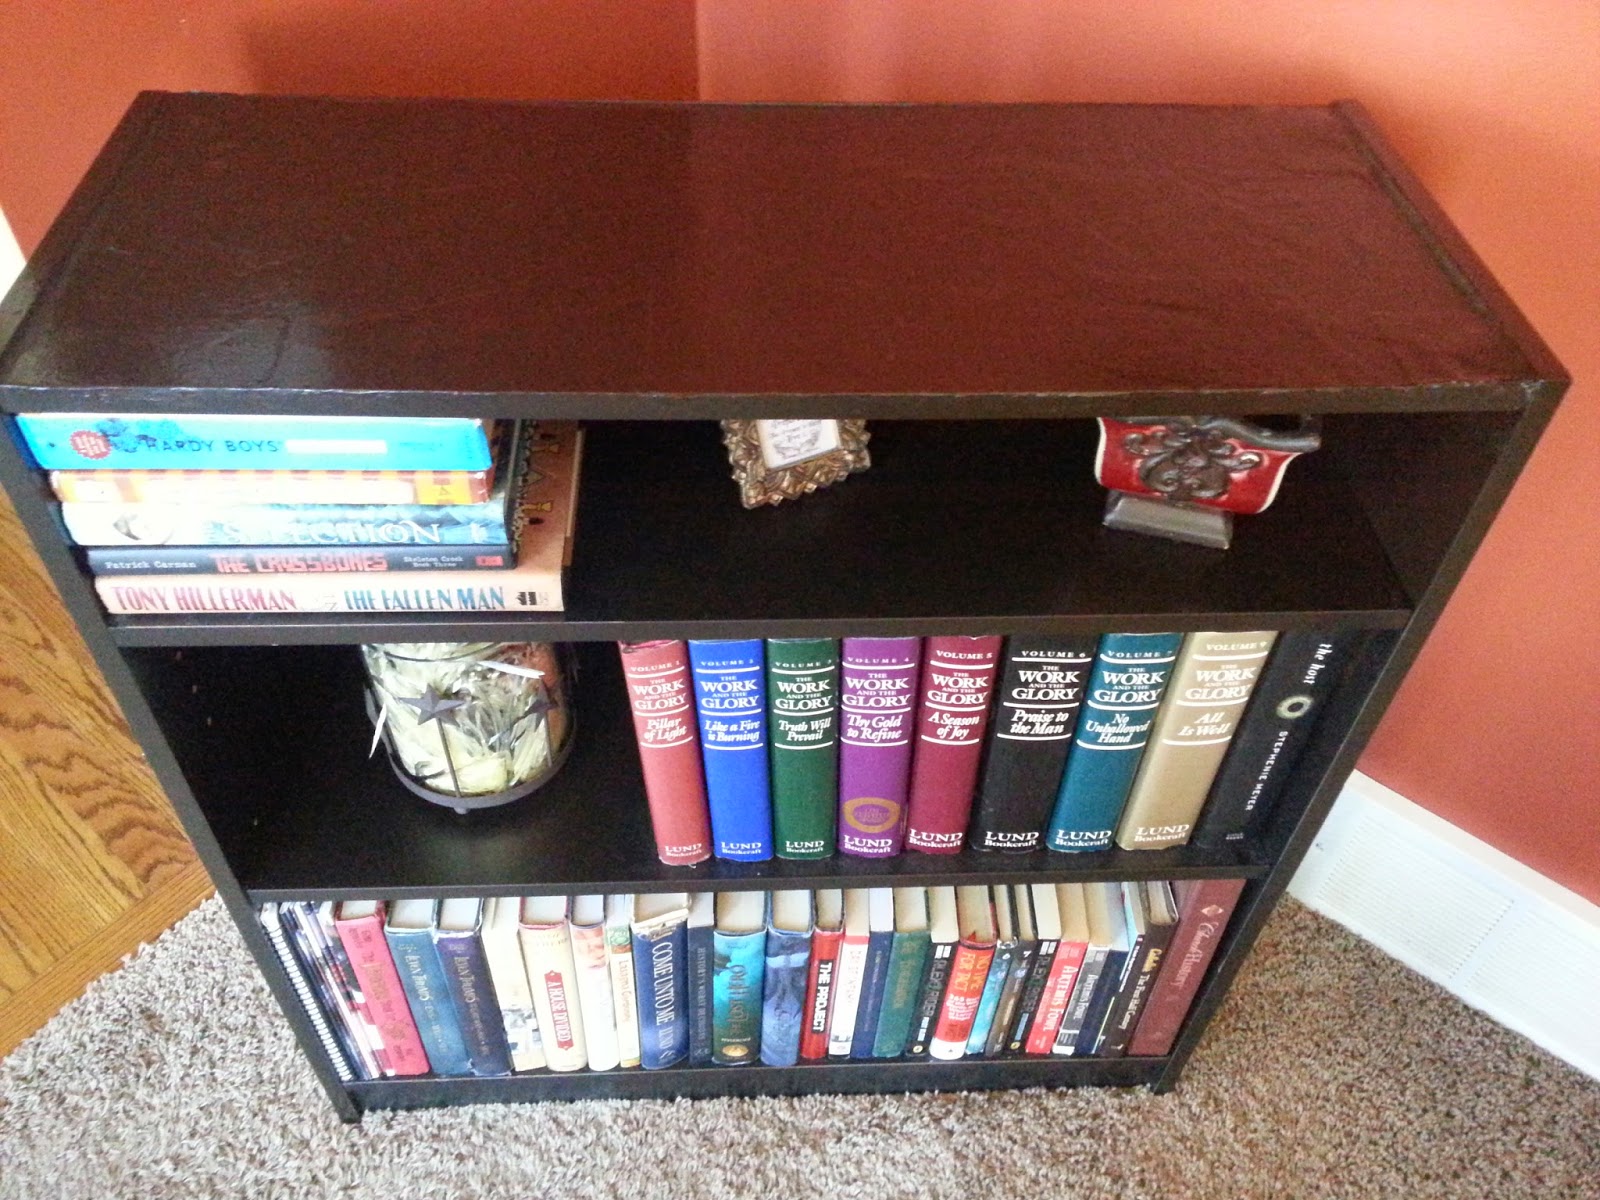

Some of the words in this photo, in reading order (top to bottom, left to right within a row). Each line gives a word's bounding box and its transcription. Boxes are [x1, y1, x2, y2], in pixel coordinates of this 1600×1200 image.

[225, 439, 279, 451] BOYS
[104, 561, 150, 569] Patrick
[210, 554, 250, 573] THE
[255, 552, 388, 573] CROSSBONES
[111, 586, 171, 610] TONY
[173, 586, 298, 611] HILLERMAN
[344, 590, 376, 610] THE
[381, 588, 455, 610] FALLEN
[457, 586, 505, 610] MAN
[1206, 642, 1258, 651] VOLUME
[1313, 643, 1333, 661] the
[935, 650, 983, 660] VOLUME
[1021, 650, 1075, 658] VOLUME
[1107, 650, 1162, 658] VOLUME
[630, 663, 672, 672] VOLUME
[1196, 667, 1258, 682] WORK
[1303, 664, 1325, 685] host
[845, 676, 910, 691] WORK
[931, 673, 989, 688] WORK
[1018, 669, 1080, 684] WORK
[1102, 670, 1166, 684] WORK
[632, 679, 684, 695] WORK
[700, 678, 758, 693] WORK
[776, 679, 830, 694] WORK
[1185, 684, 1251, 699] GLORY
[842, 694, 911, 708] GLORY
[927, 690, 988, 704] GLORY
[1011, 687, 1079, 701] GLORY
[1094, 688, 1162, 703] GLORY
[635, 693, 686, 710] GLORY
[701, 695, 759, 710] GLORY
[775, 696, 832, 710] GLORY
[847, 713, 871, 728] Thy
[871, 714, 903, 728] Gold
[928, 712, 942, 723] A
[943, 712, 980, 725] Season
[1011, 710, 1053, 722] Praise
[1056, 711, 1069, 722] to
[1112, 713, 1130, 724] No
[1194, 712, 1223, 724] All
[646, 717, 681, 730] Pillar
[704, 720, 728, 731] Like
[729, 722, 737, 731] a
[739, 720, 761, 731] Fire
[778, 720, 808, 731] Truth
[810, 717, 832, 730] Will
[1010, 722, 1030, 734] the
[1031, 722, 1064, 734] Man
[1085, 719, 1150, 734] Unhallowed
[1178, 725, 1192, 736] Is
[1193, 723, 1230, 736] Well
[644, 729, 656, 742] of
[656, 726, 687, 740] Light
[708, 731, 717, 741] is
[717, 729, 760, 742] Burning
[786, 728, 823, 741] Prevail
[847, 727, 858, 738] to
[860, 727, 903, 743] Refine
[936, 726, 950, 739] of
[950, 726, 970, 740] Joy
[1097, 733, 1131, 743] Hand
[1258, 731, 1289, 781] STEPHENIE
[1245, 783, 1265, 811] MEYER
[909, 828, 963, 842] LUND
[985, 831, 1040, 842] LUND
[1057, 829, 1112, 840] LUND
[1135, 824, 1191, 836] LUND
[844, 835, 893, 847] LUND
[909, 836, 962, 848] Bookcraft
[984, 839, 1037, 847] Bookcraft
[1055, 838, 1109, 847] Bookcraft
[1134, 832, 1186, 843] Bookcraft
[664, 843, 702, 853] LUND
[721, 842, 762, 850] LUND
[786, 841, 825, 849] LUND
[845, 843, 891, 853] Bookcraft
[666, 849, 702, 858] Bookcraft
[1187, 920, 1218, 957] Church
[652, 942, 673, 976] COME
[959, 952, 976, 970] FOR
[976, 956, 990, 969] NO
[818, 961, 832, 987] THE
[1172, 952, 1201, 989] History
[548, 980, 564, 988] A
[954, 972, 970, 992] TACT
[1051, 966, 1078, 1006] ARTEMIS
[1080, 975, 1098, 1002] ARTEMIS
[654, 974, 674, 1009] UNTO
[549, 986, 566, 1012] HOUSE
[657, 1007, 674, 1025] ME
[813, 988, 830, 1032] PROJECT
[1073, 1003, 1089, 1019] FOWL
[1042, 1008, 1064, 1031] FOWL
[554, 1012, 571, 1042] DIVIDED
[660, 1026, 673, 1049] LUND
